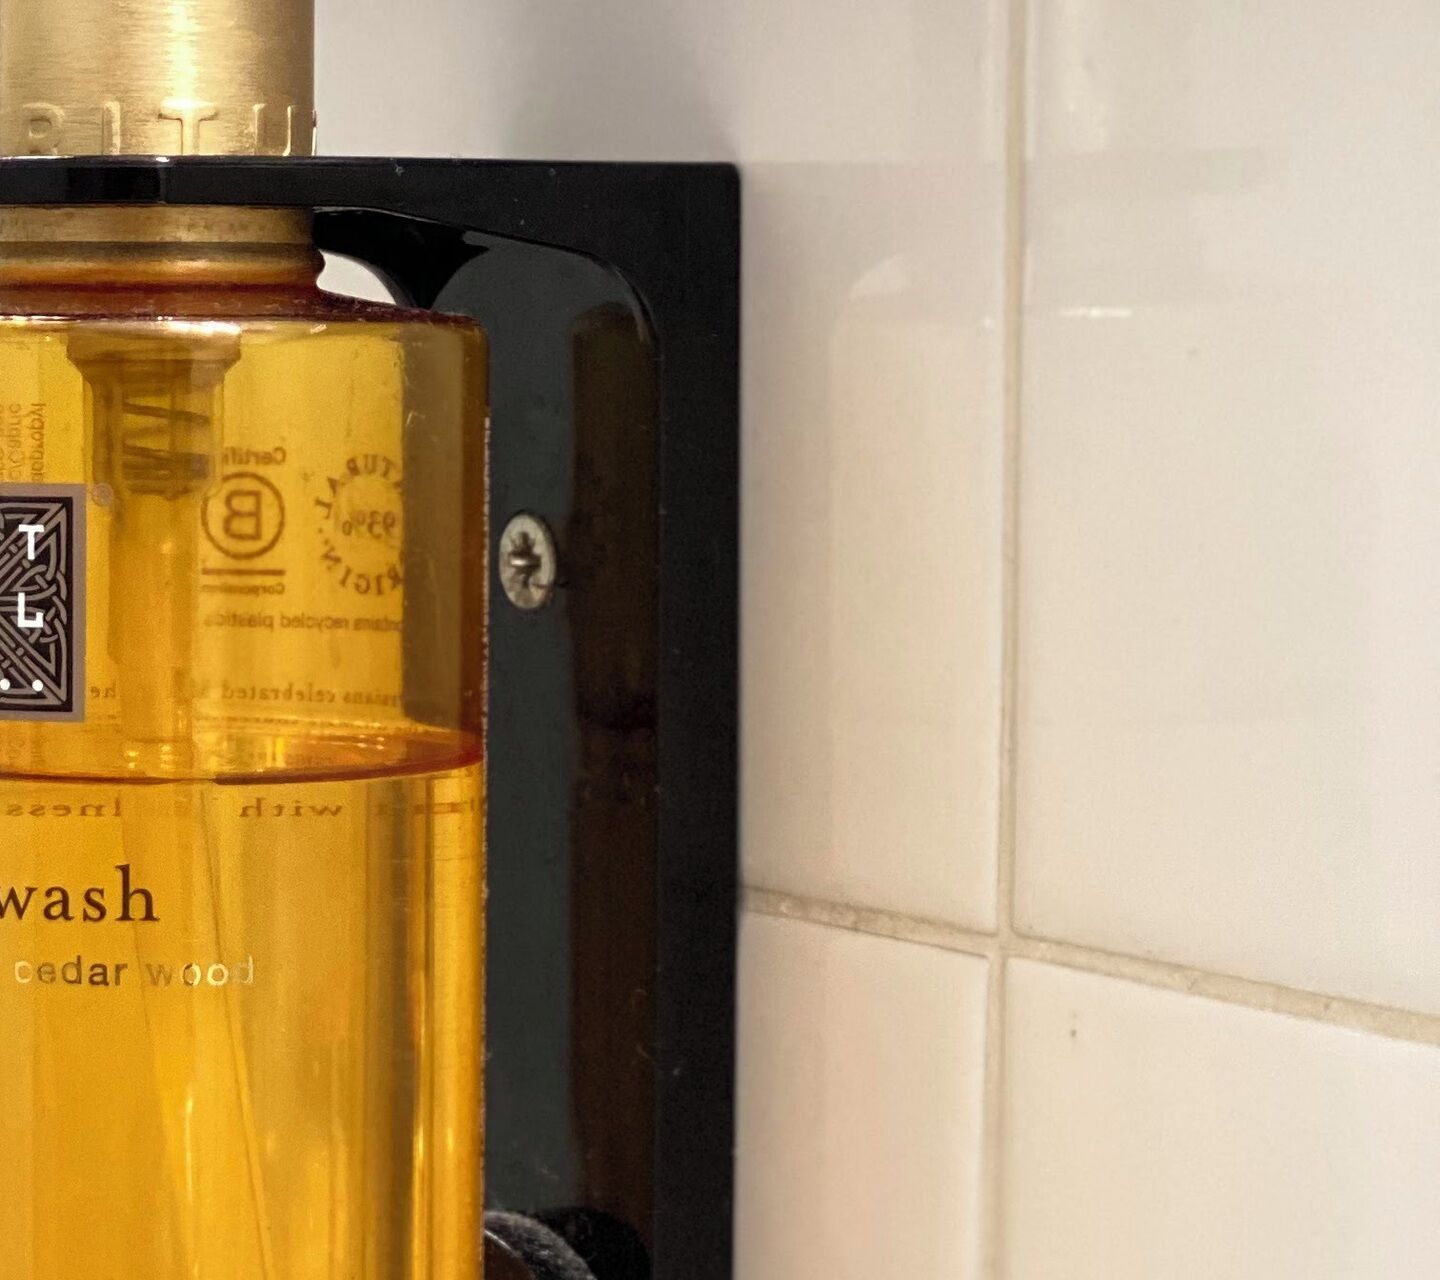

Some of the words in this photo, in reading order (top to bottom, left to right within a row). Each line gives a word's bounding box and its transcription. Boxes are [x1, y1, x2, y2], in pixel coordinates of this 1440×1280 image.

[18, 98, 318, 156] RITU
[14, 954, 128, 987] cedar
[146, 954, 256, 987] wood
